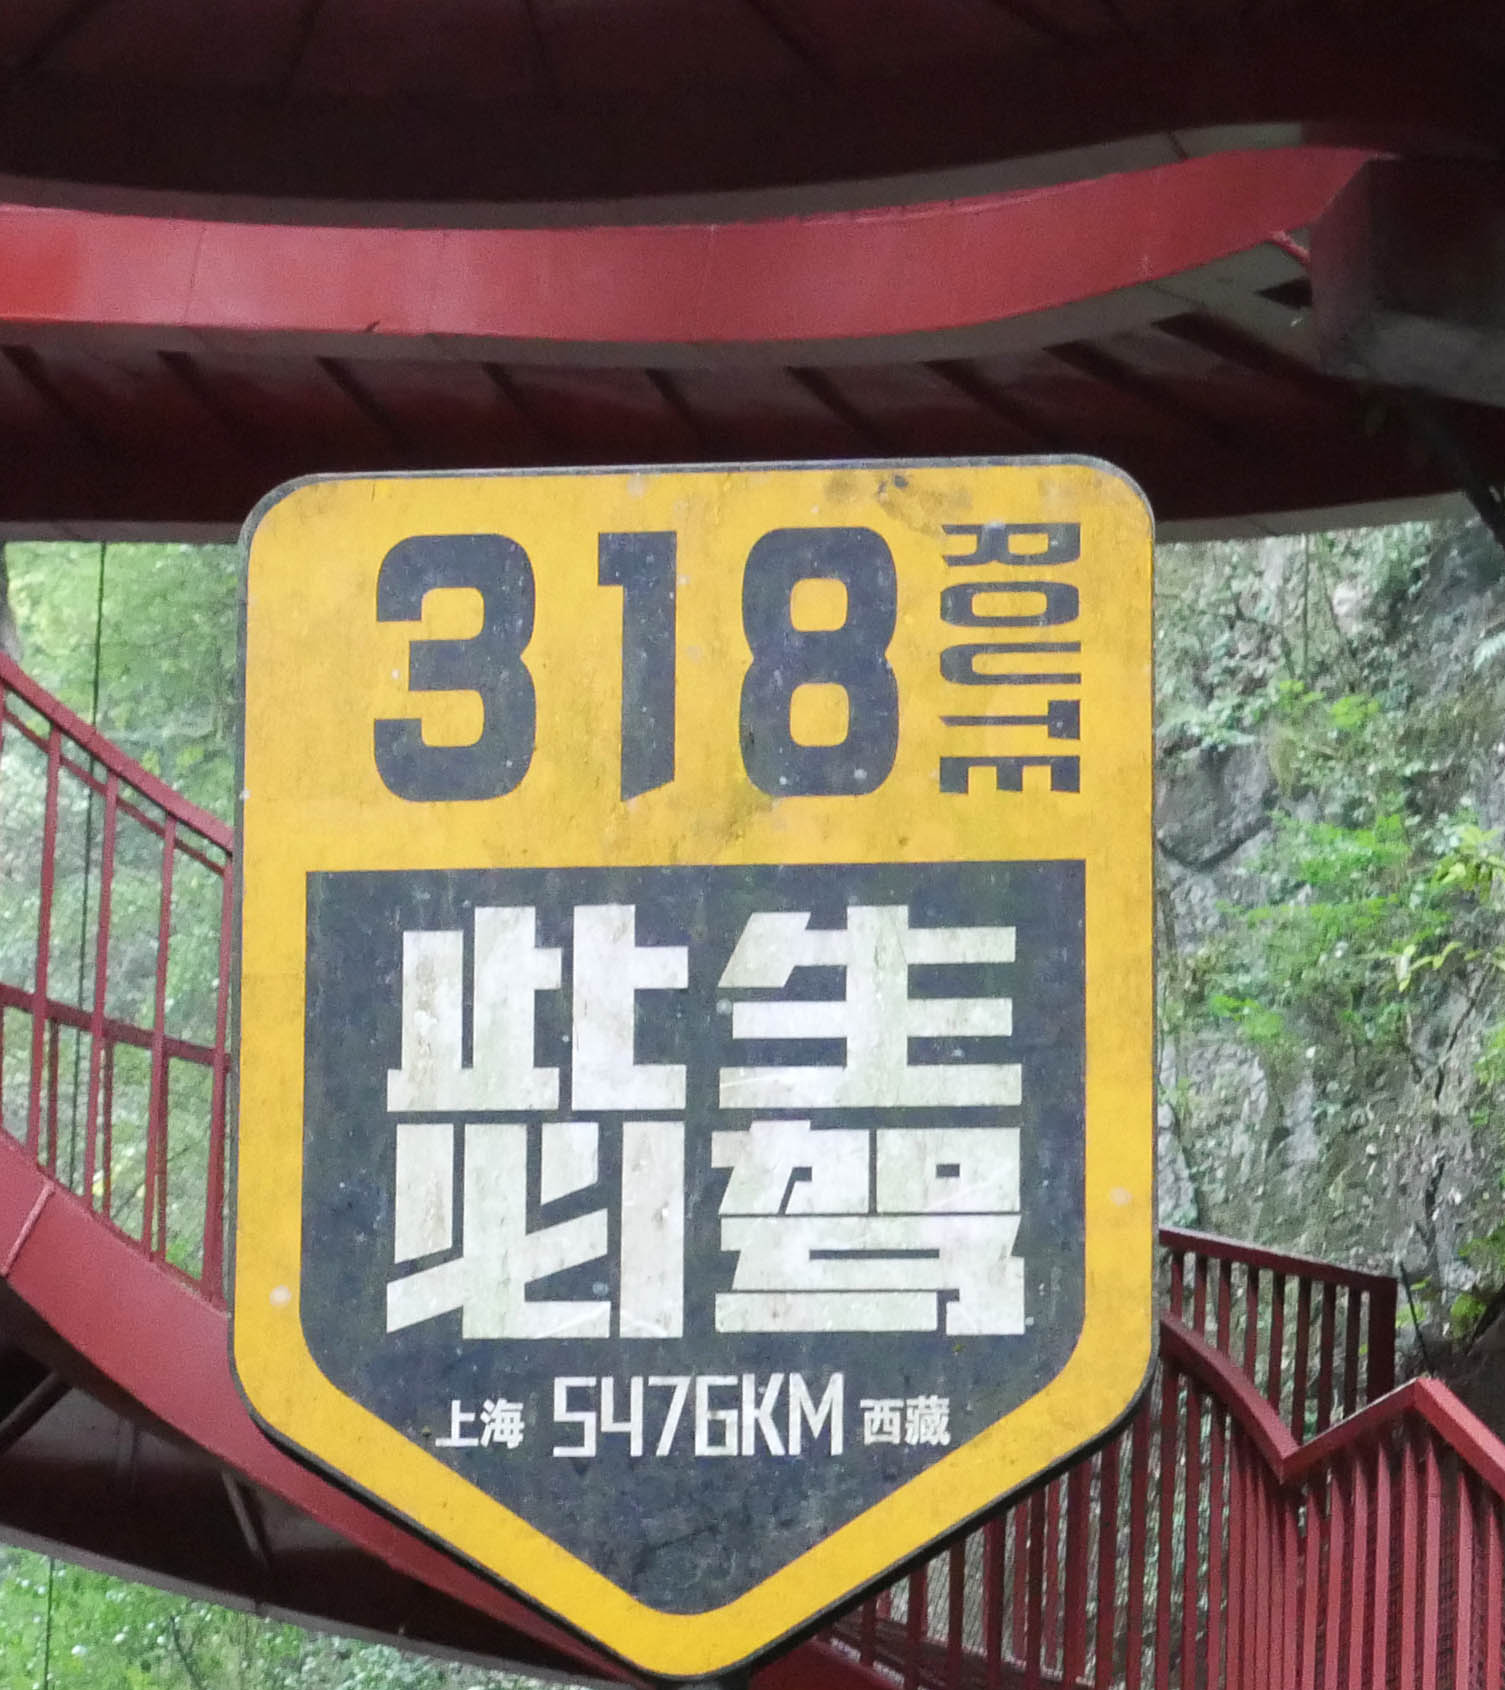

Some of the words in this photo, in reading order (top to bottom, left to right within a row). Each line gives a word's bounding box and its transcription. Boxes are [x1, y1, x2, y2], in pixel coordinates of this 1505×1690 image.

[373, 526, 899, 803] 318
[939, 522, 1081, 795] ROUTE
[386, 902, 1023, 1112] 此生
[385, 1119, 1035, 1340] 必驾
[433, 1396, 527, 1450] 上海
[551, 1371, 846, 1458] 5476KM
[859, 1393, 954, 1449] 西藏
